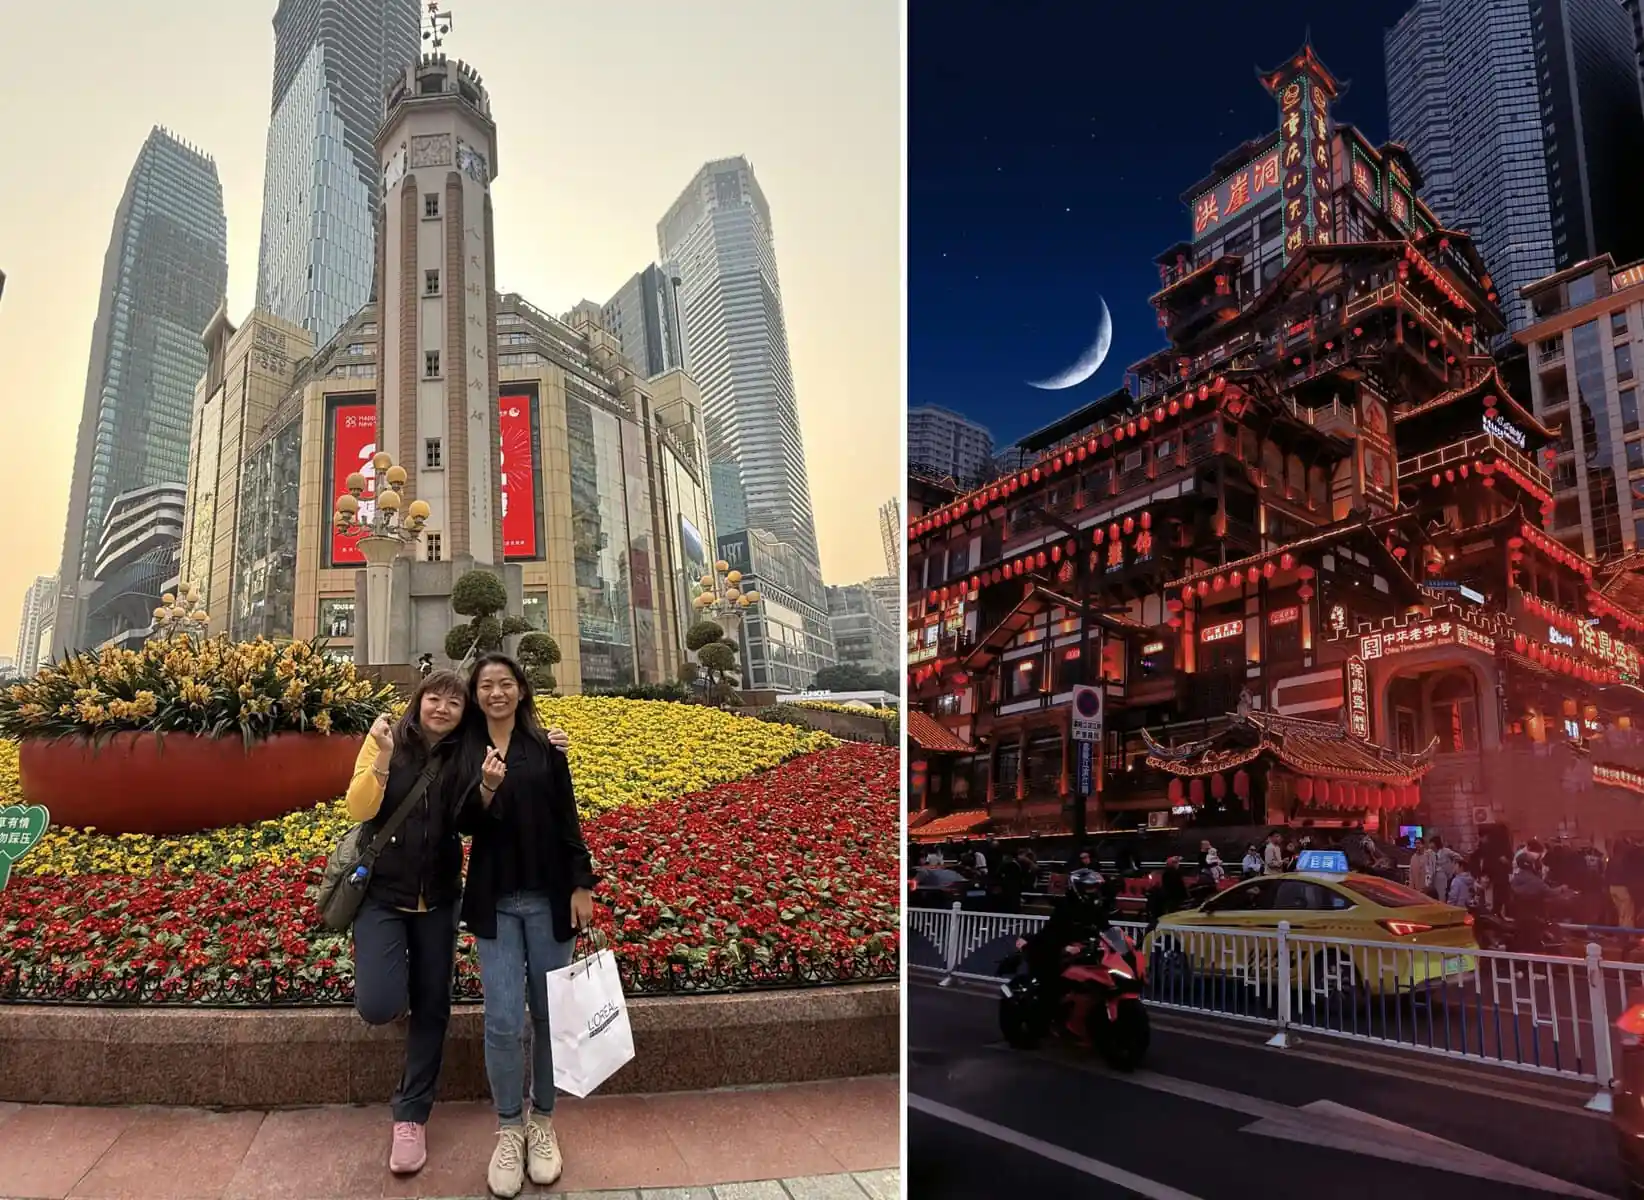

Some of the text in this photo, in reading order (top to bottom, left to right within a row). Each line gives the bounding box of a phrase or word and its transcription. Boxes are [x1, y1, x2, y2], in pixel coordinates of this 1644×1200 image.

[1195, 152, 1279, 233] 洪崖洞
[1383, 622, 1452, 646] 中华老字号
